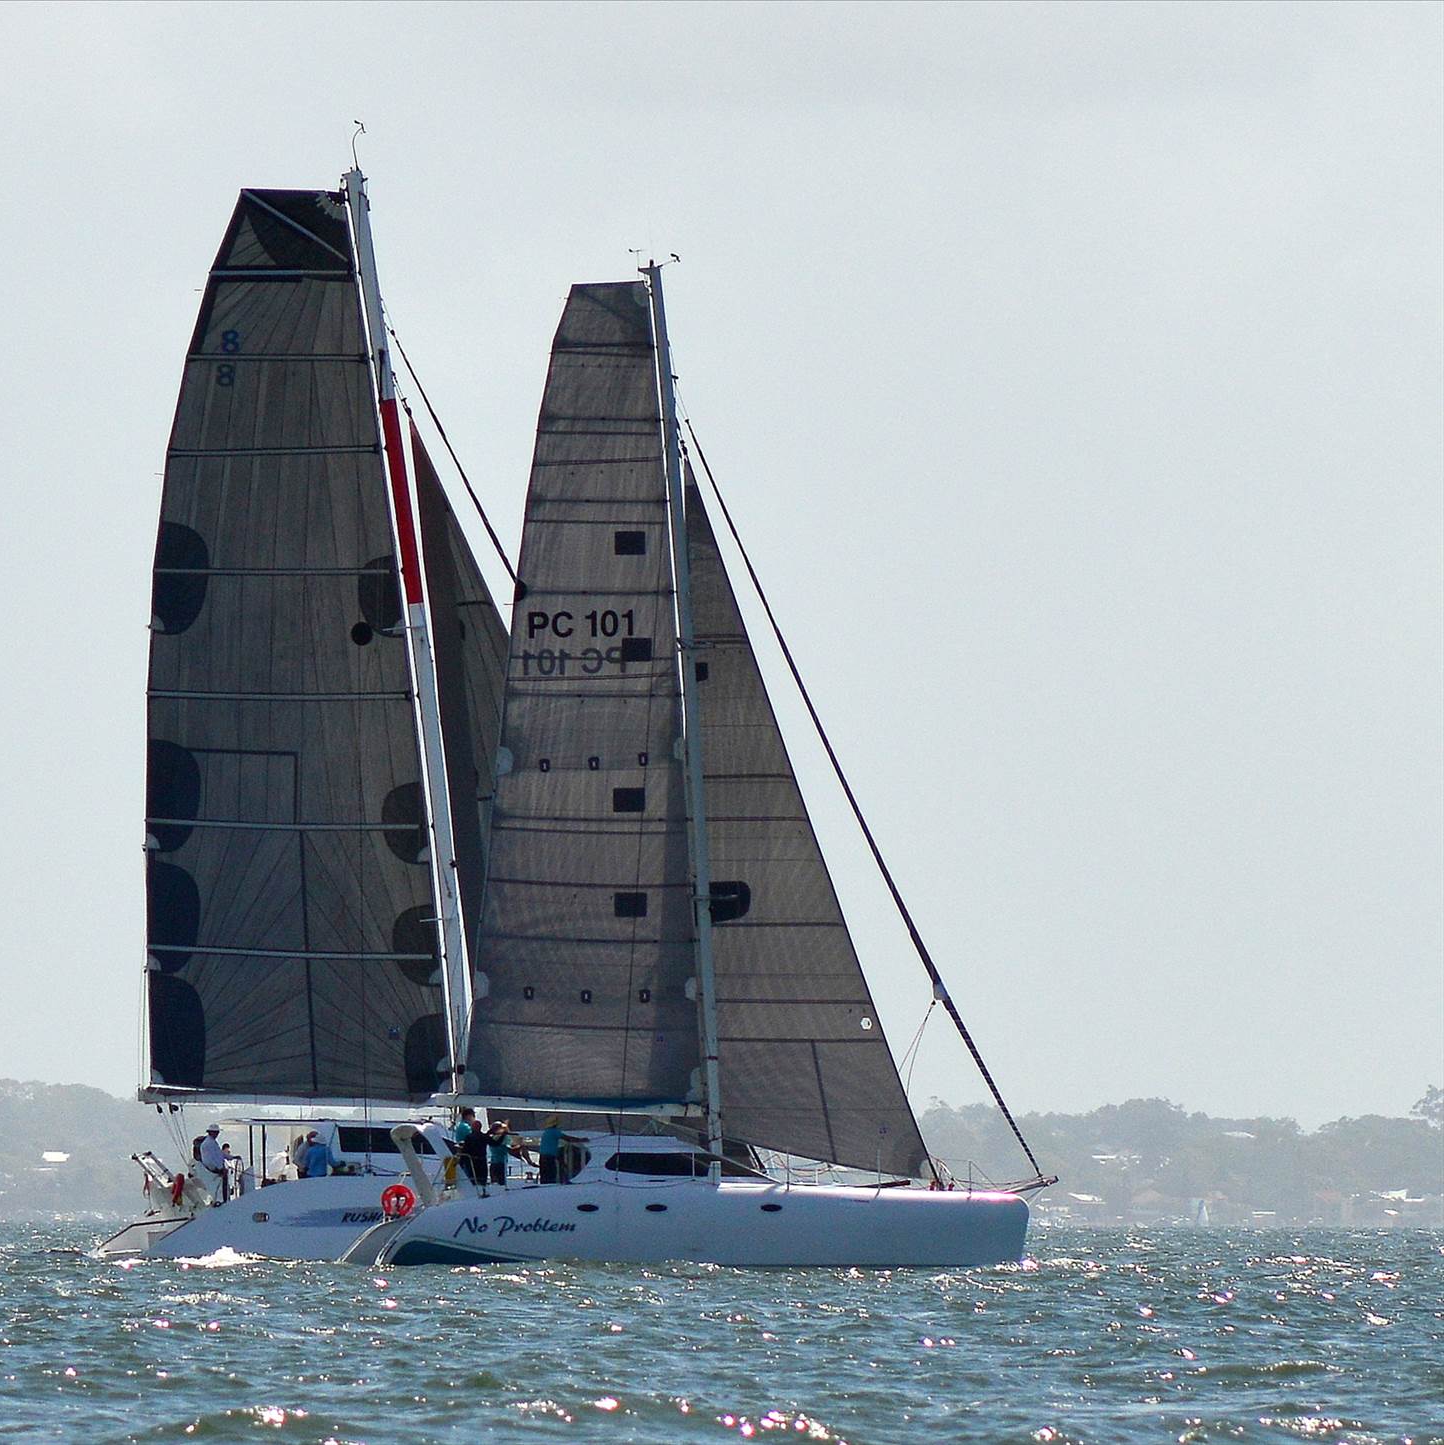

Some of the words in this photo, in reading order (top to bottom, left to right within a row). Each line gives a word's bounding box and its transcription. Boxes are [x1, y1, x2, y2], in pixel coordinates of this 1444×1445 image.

[221, 329, 241, 353] 8
[528, 610, 575, 639] PC
[585, 608, 635, 638] 101
[452, 1215, 489, 1239] No
[493, 1215, 576, 1238] Problem
